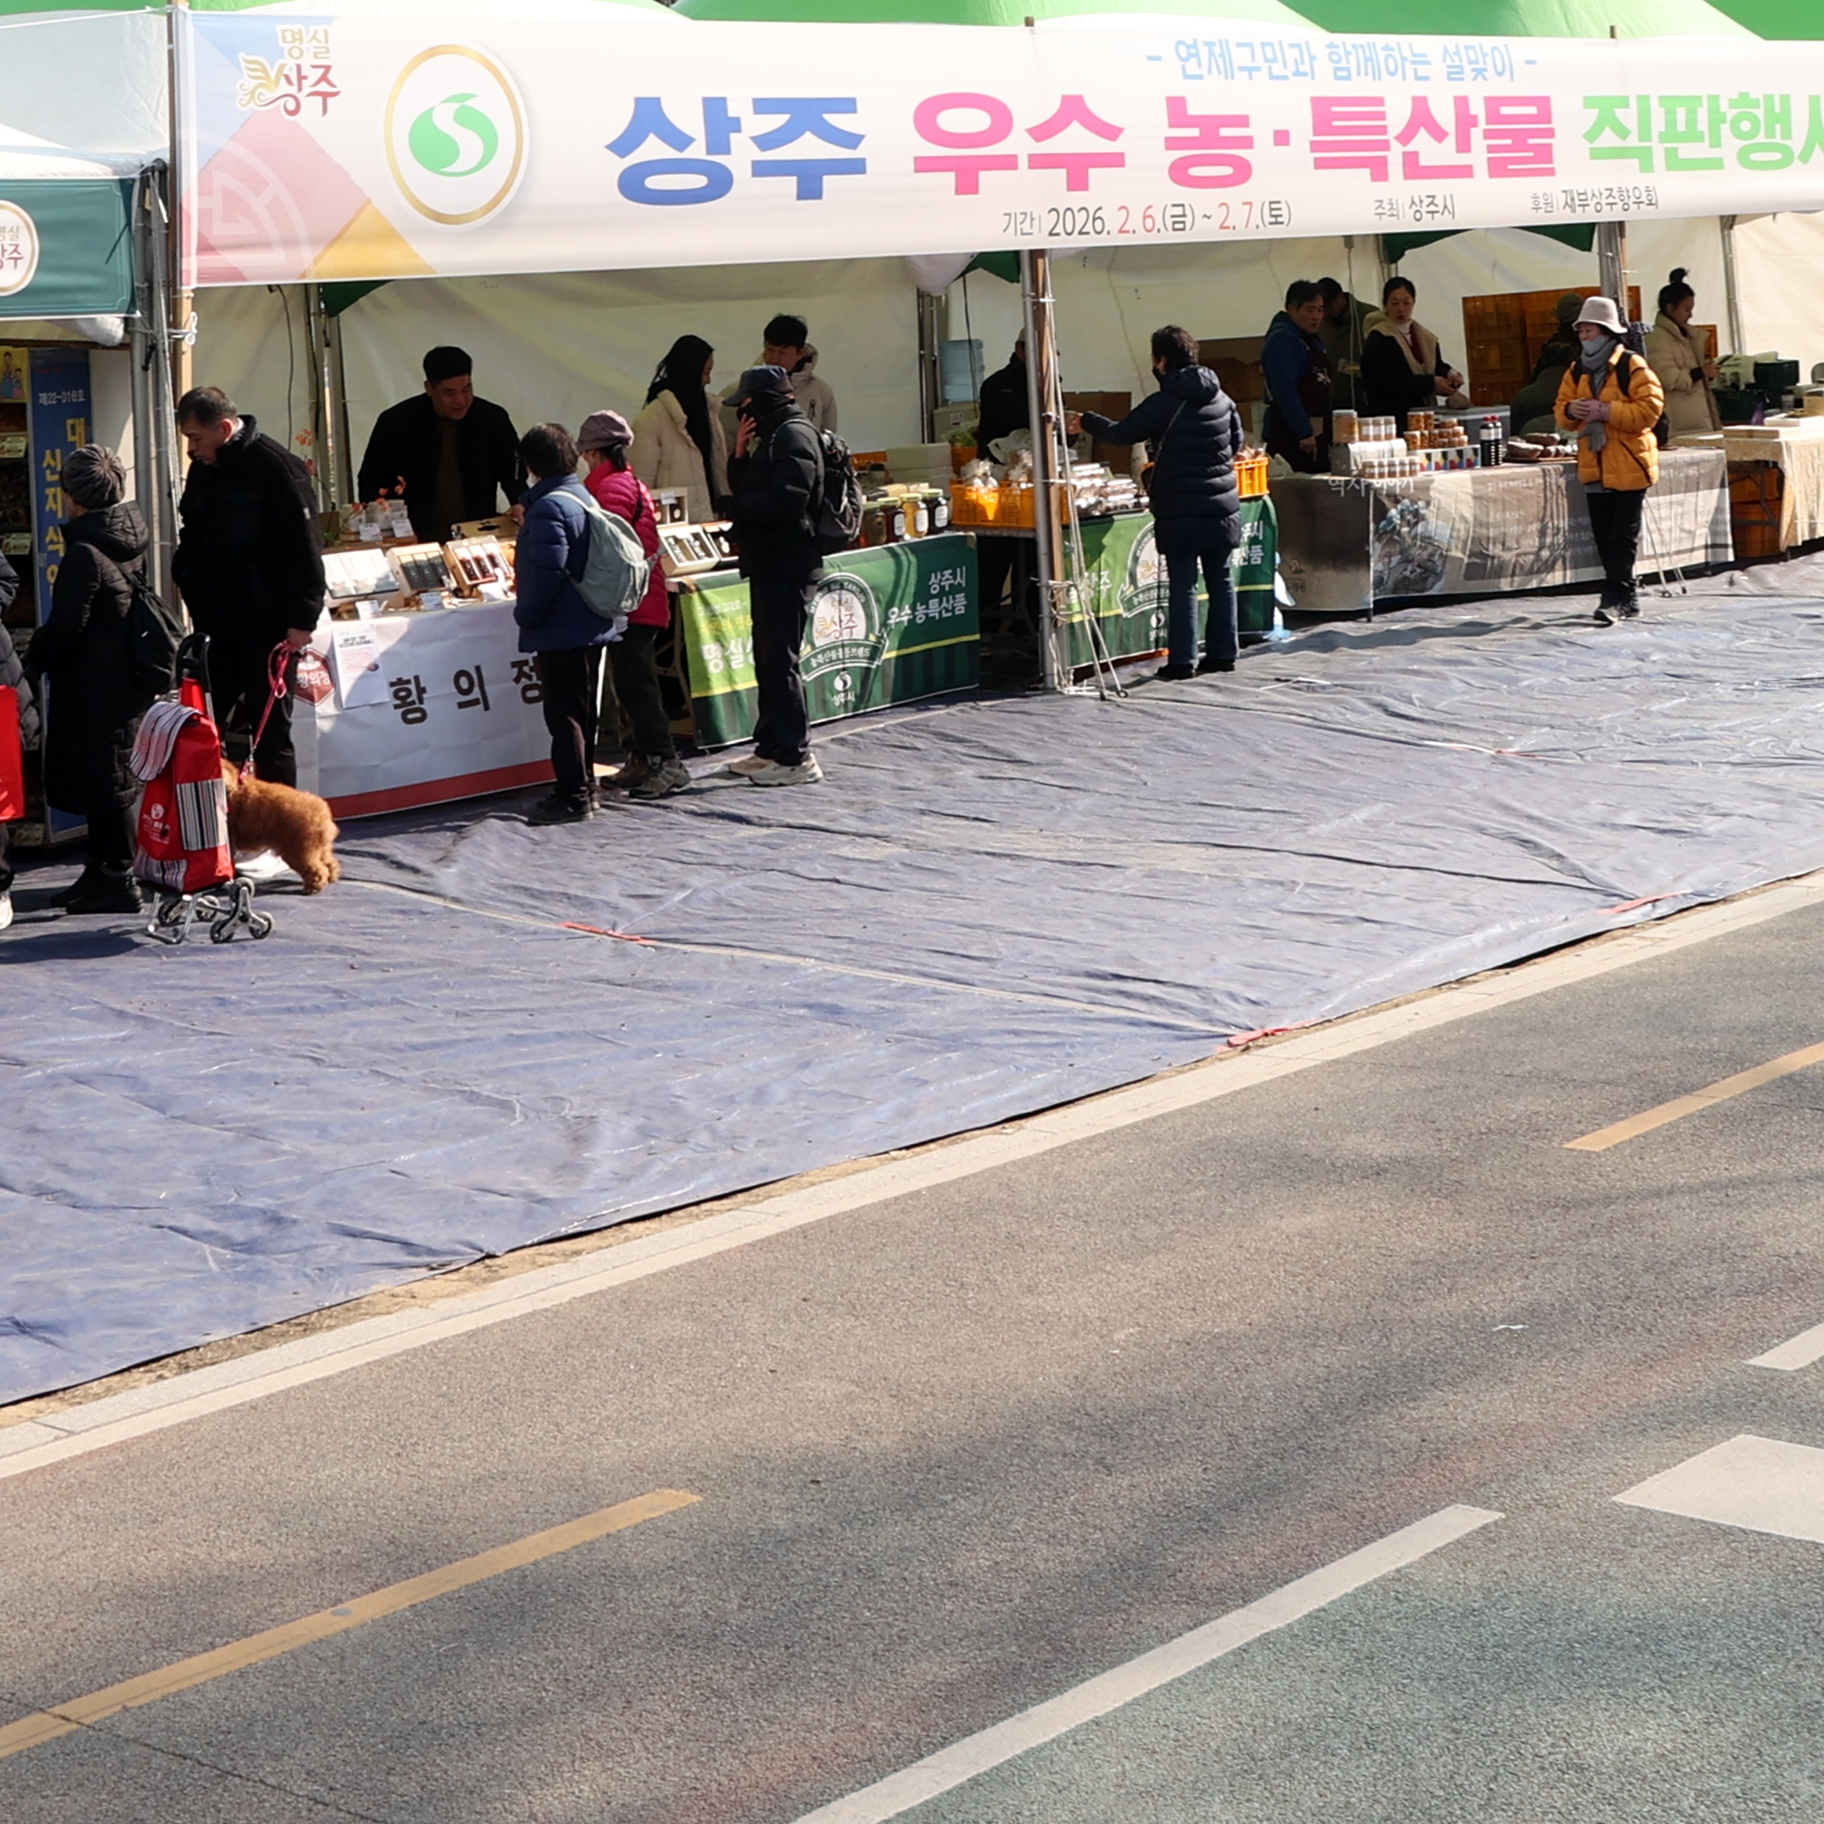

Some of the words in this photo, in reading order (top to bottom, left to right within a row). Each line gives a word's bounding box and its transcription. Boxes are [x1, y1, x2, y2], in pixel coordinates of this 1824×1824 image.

[279, 28, 331, 60] 명실
[1175, 38, 1316, 81] 연제구민과
[1328, 41, 1432, 82] 함께하는
[1442, 43, 1515, 81] 설맞이
[266, 63, 342, 117] 상주
[606, 95, 867, 207] 상주
[913, 91, 1126, 195] 우수
[1047, 206, 1111, 237] 2026.
[1409, 194, 1456, 222] 상주시
[928, 566, 966, 595] 상주시
[887, 603, 913, 629] 우수
[915, 592, 967, 624] 농특산품
